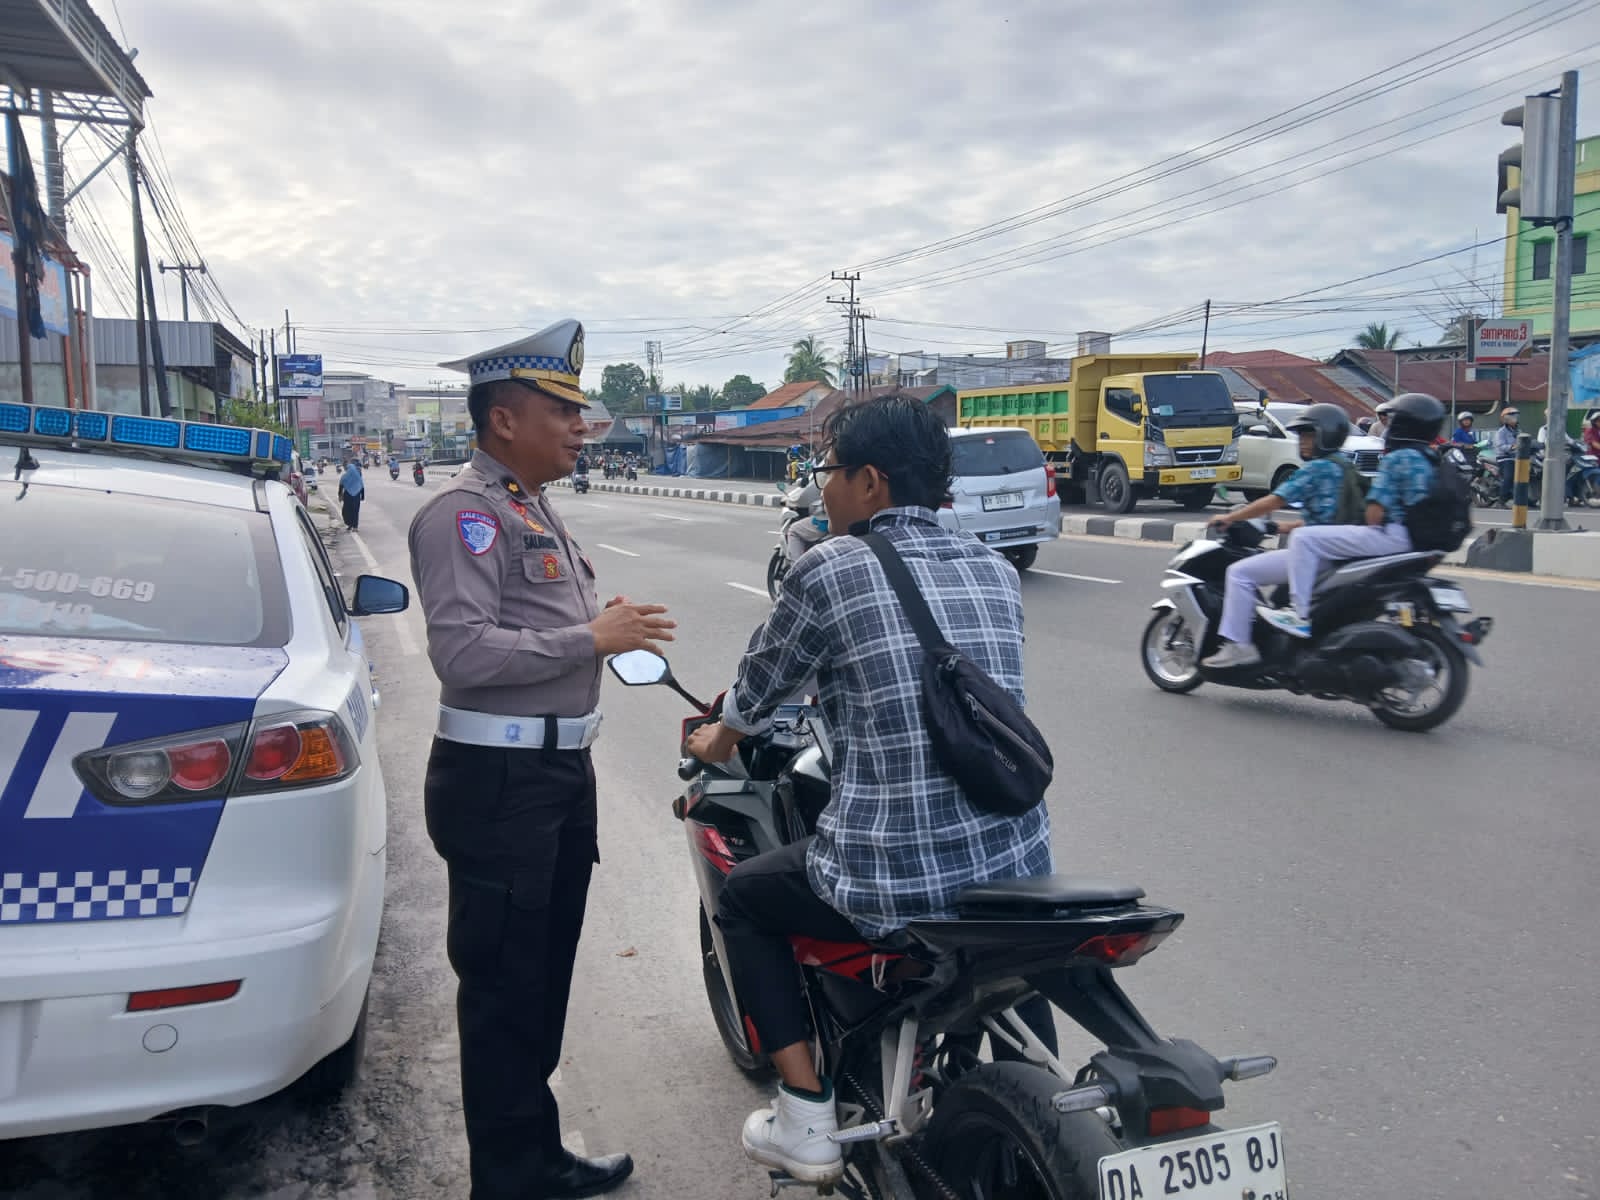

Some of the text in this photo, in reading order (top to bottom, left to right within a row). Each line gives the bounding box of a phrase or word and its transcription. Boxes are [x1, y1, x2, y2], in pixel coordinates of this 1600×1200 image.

[1519, 323, 1528, 340] 3
[1107, 1164, 1144, 1200] DA
[1159, 1143, 1231, 1195] 2505
